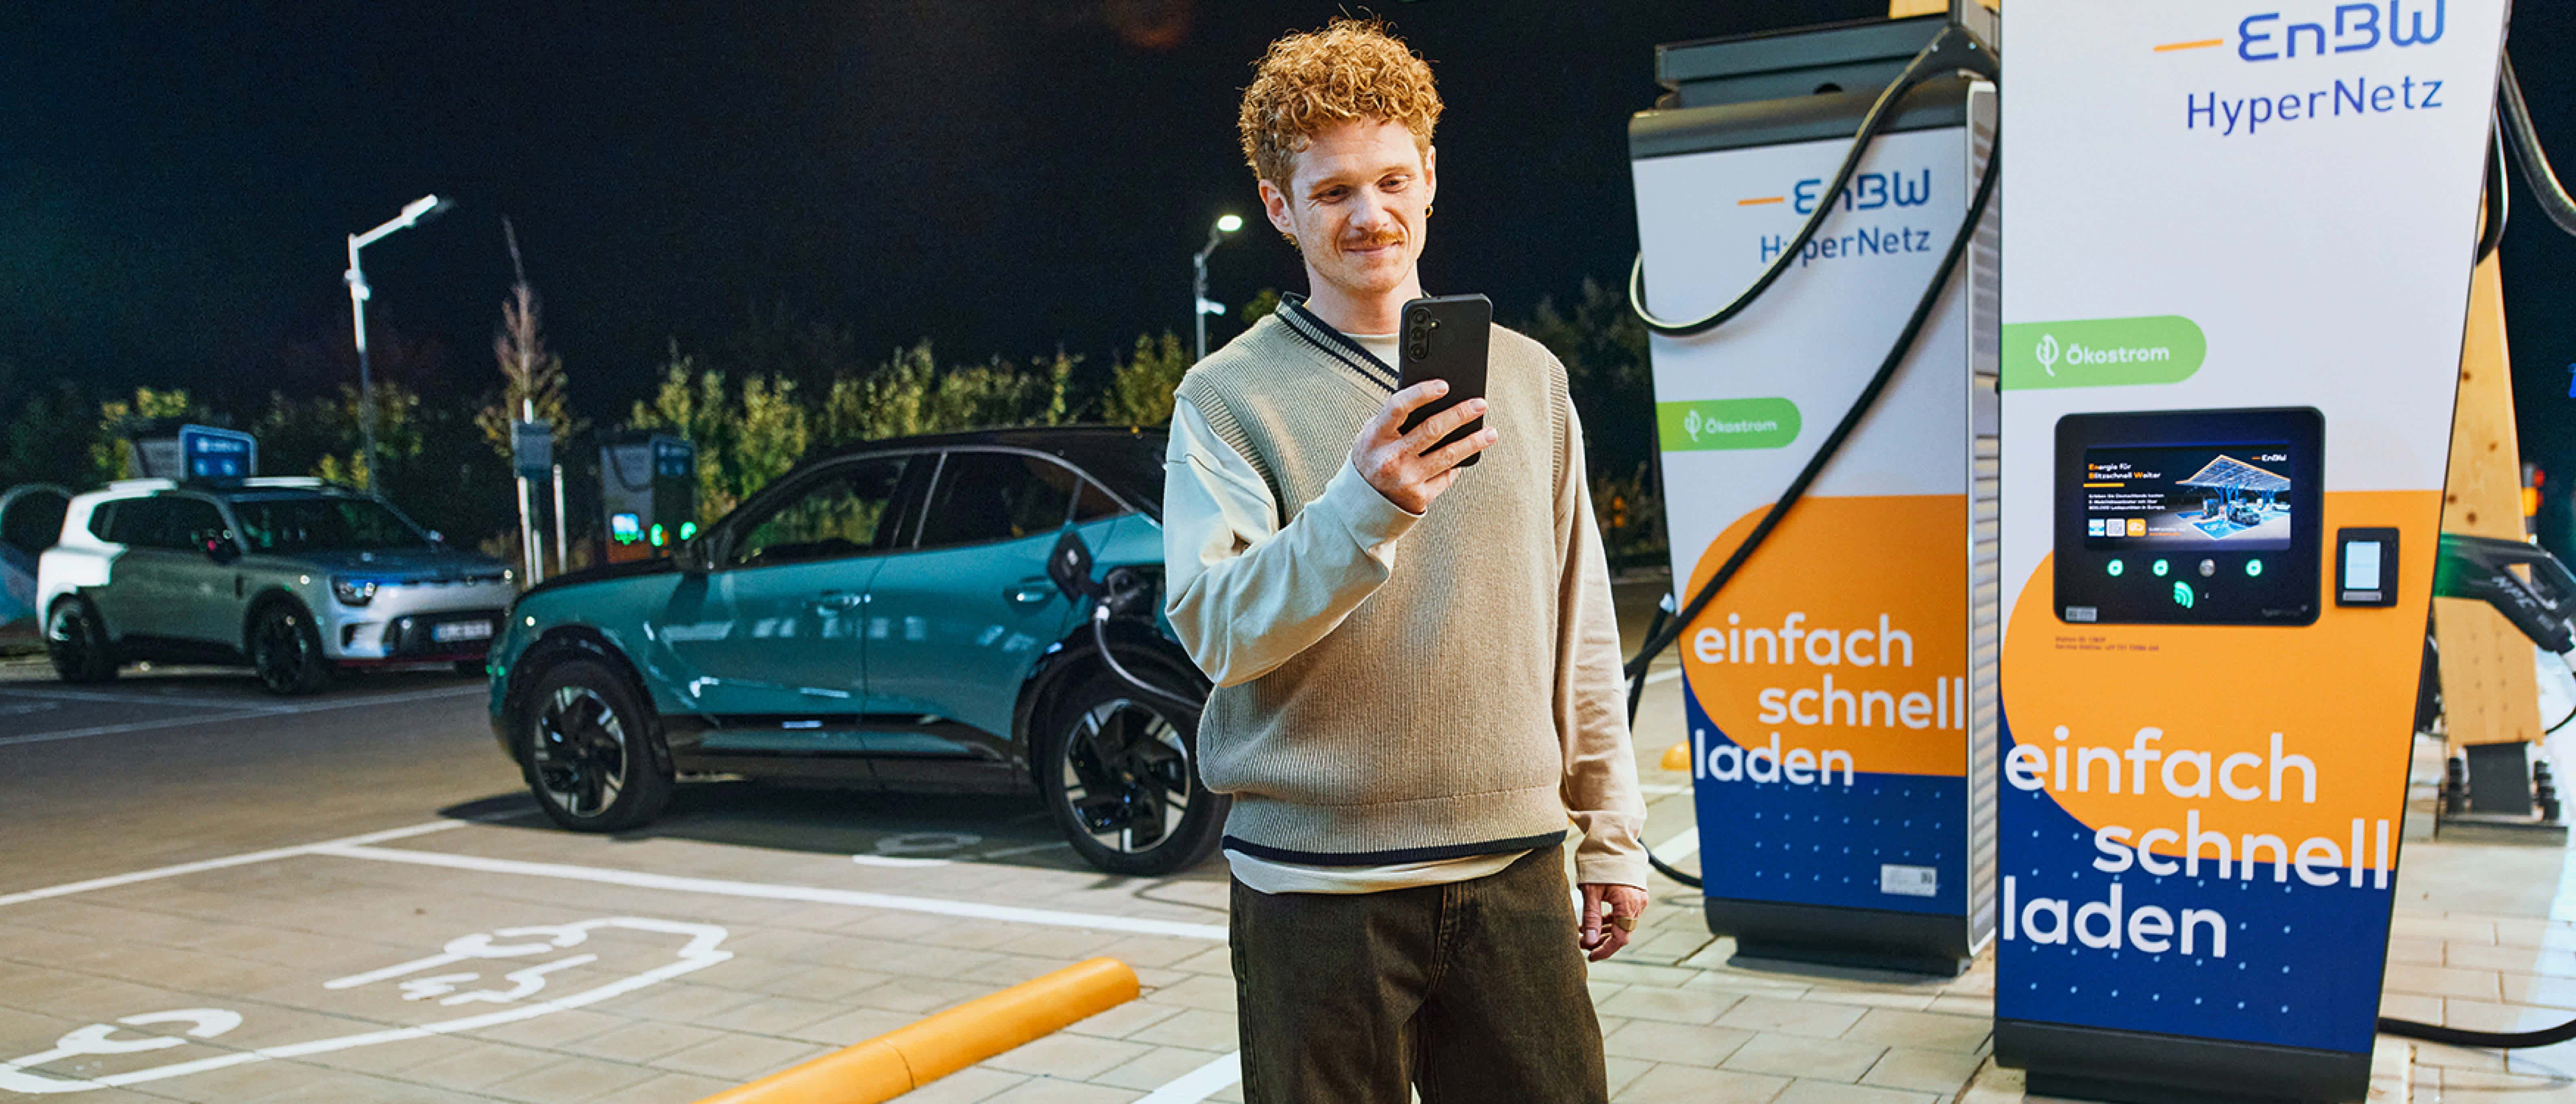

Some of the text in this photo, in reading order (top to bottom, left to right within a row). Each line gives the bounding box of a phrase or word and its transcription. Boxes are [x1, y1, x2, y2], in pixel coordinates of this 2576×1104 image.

[2238, 0, 2445, 62] EnBW
[2188, 76, 2443, 136] HyperNetz
[1760, 225, 1931, 266] HperNetz
[2066, 342, 2170, 366] Ökostrom
[1694, 612, 1913, 667] einfach
[1758, 673, 1965, 730] schnell
[1695, 729, 1855, 787] laden
[2005, 725, 2317, 804] einfach
[2093, 809, 2390, 890] schnell
[2003, 875, 2228, 958] laden
